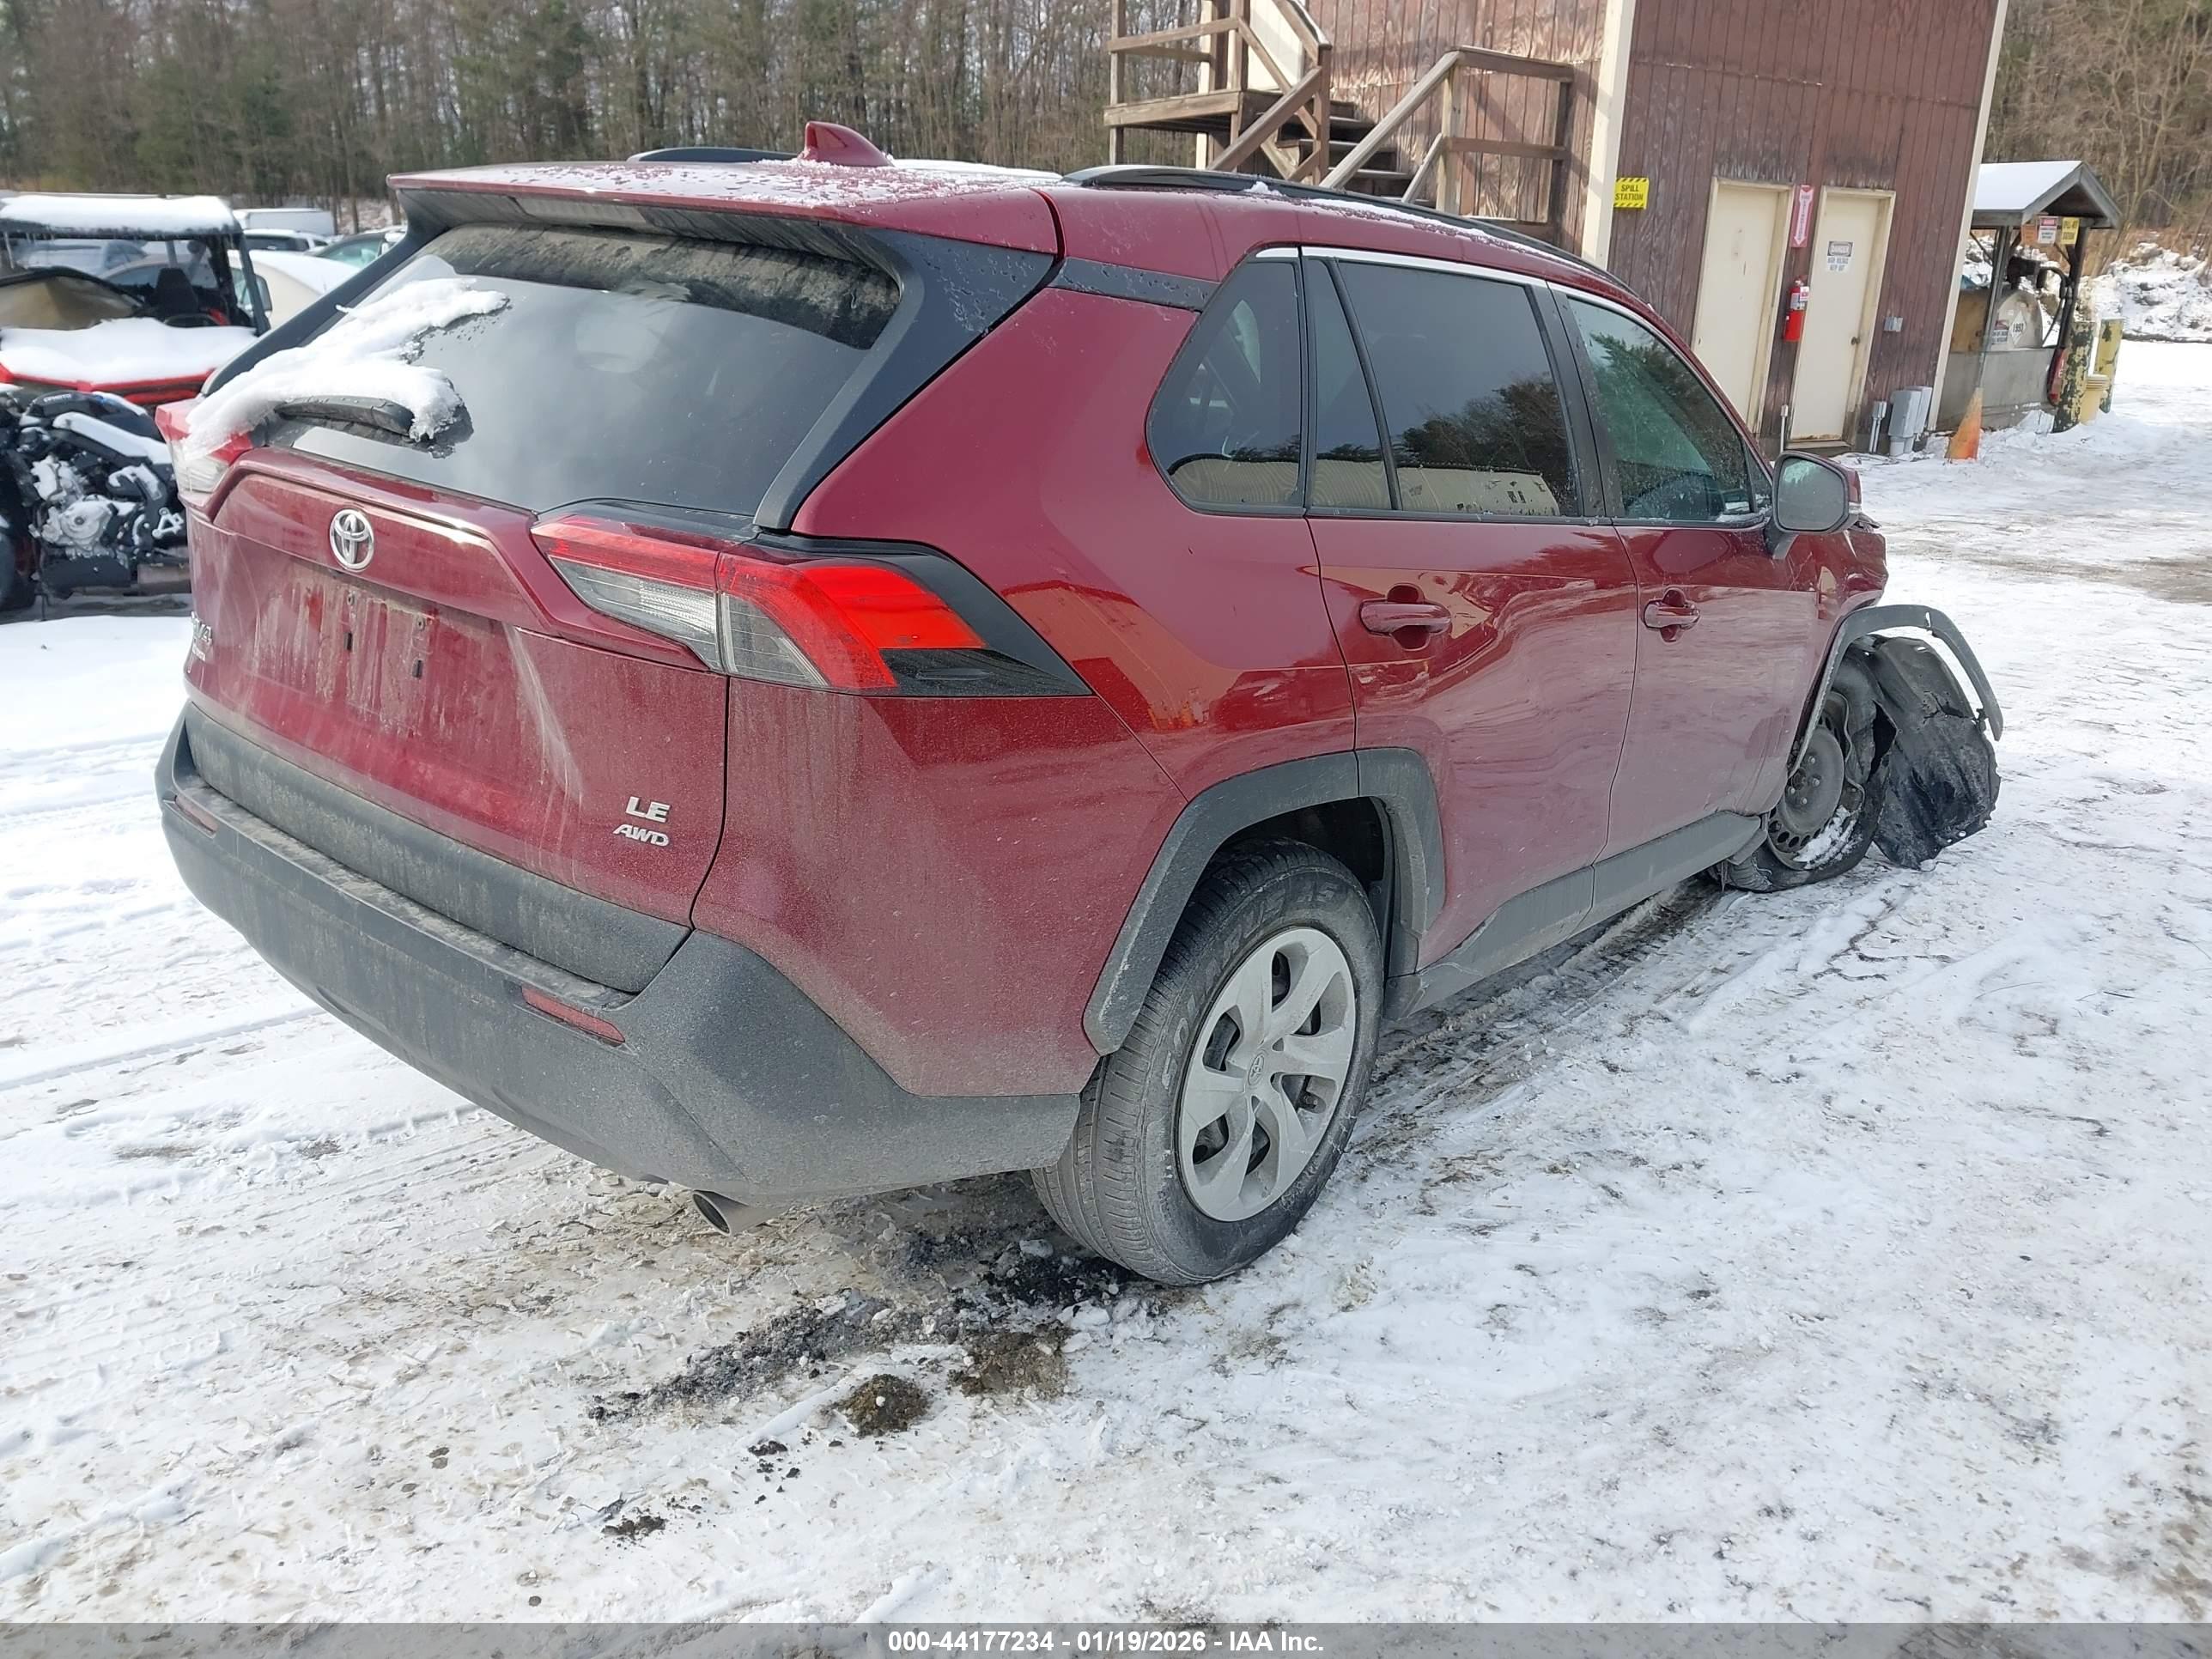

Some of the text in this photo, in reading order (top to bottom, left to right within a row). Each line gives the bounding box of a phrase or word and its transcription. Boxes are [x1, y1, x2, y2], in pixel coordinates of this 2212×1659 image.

[1620, 184, 1639, 192] SPILL
[1614, 192, 1644, 201] STATION
[625, 796, 671, 823] LE
[612, 823, 669, 847] AWD
